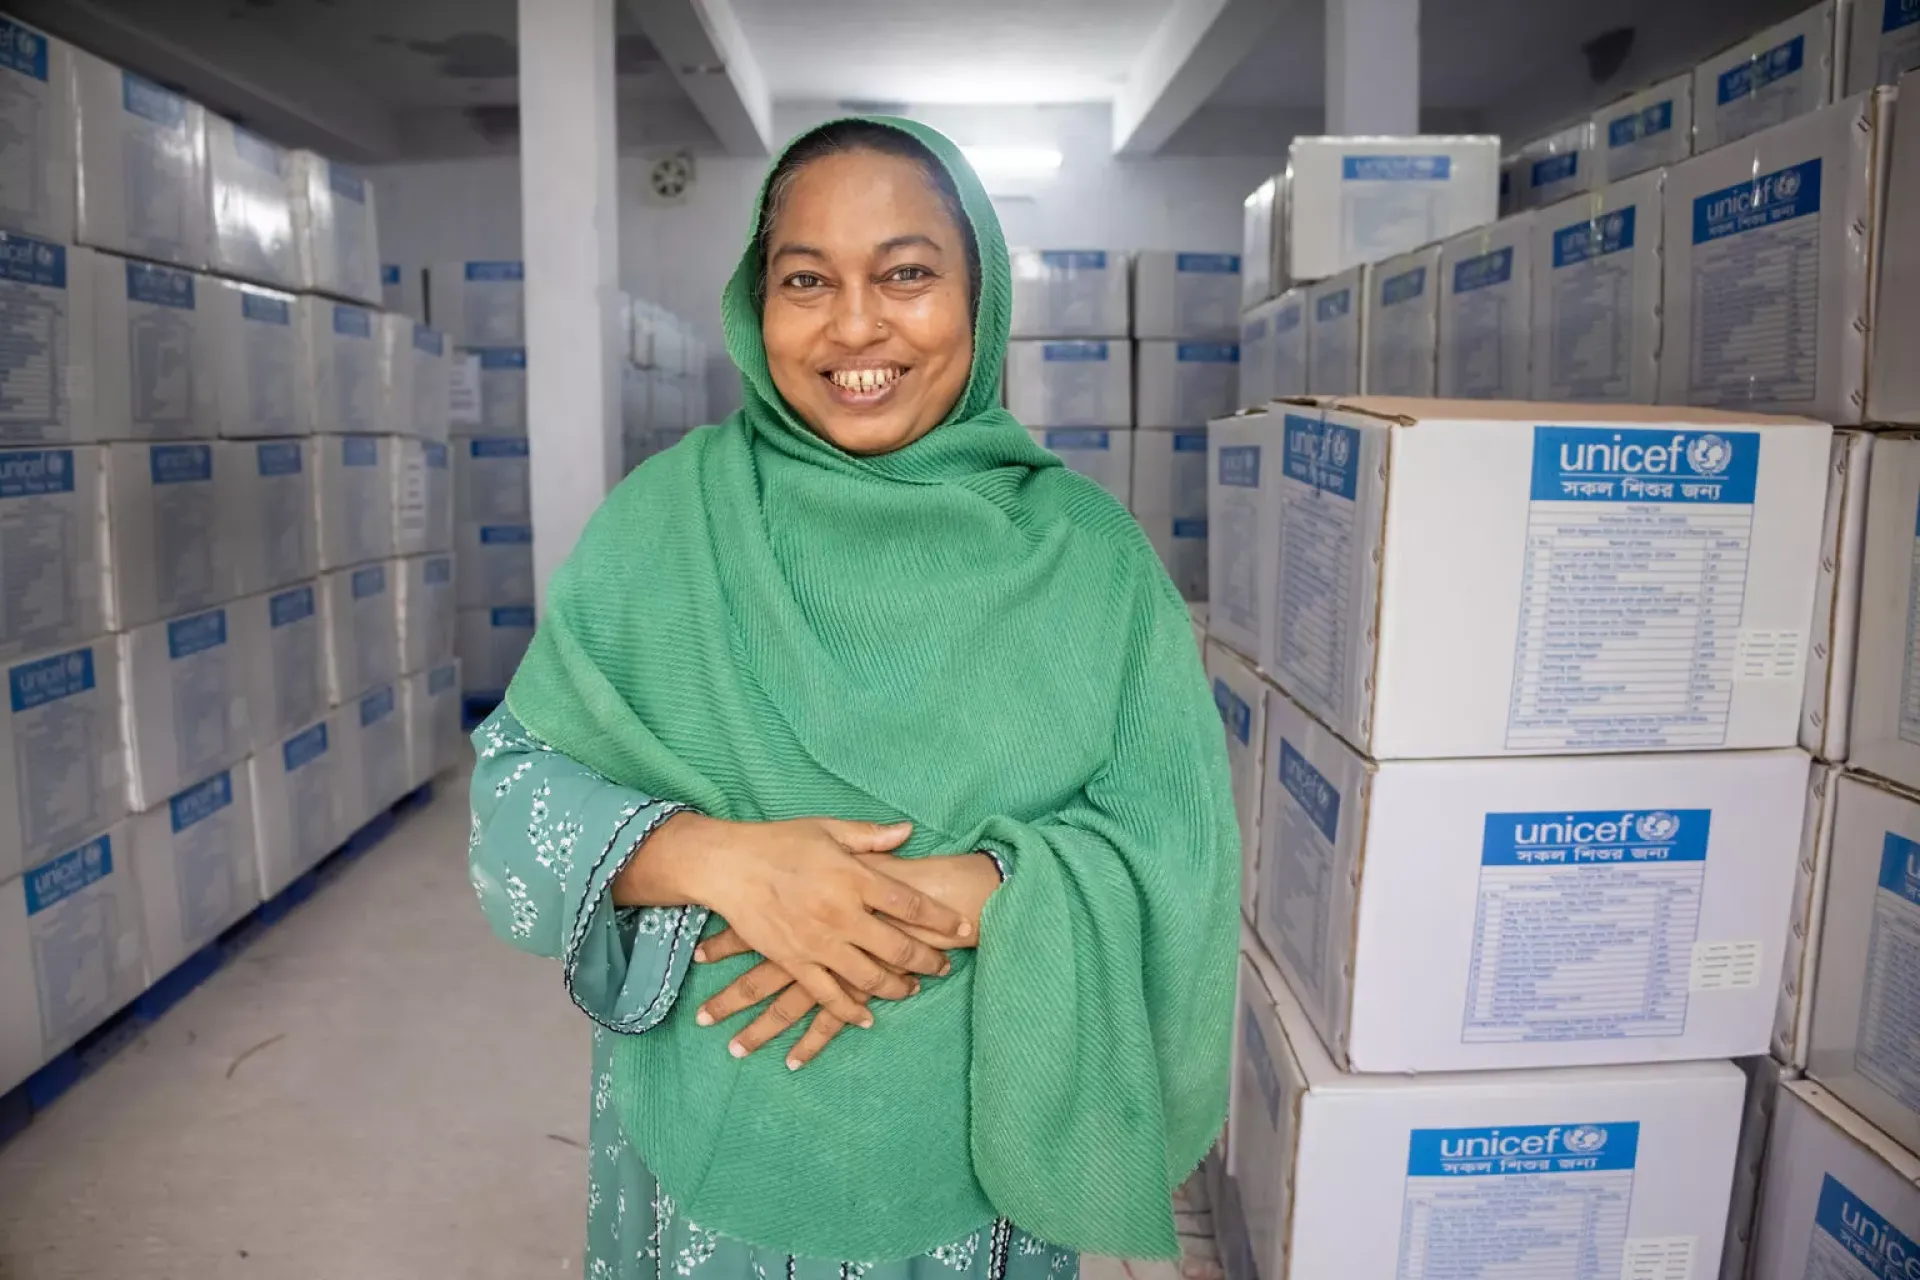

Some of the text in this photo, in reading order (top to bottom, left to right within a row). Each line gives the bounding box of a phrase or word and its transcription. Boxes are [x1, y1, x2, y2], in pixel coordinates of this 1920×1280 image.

[1560, 434, 1685, 473] unicef
[1561, 477, 1722, 501] সকল শিশুর জন্য
[1515, 813, 1634, 845] unicef
[1516, 845, 1671, 863] সকল শিশুর জন্য
[1440, 1127, 1561, 1157] unicef
